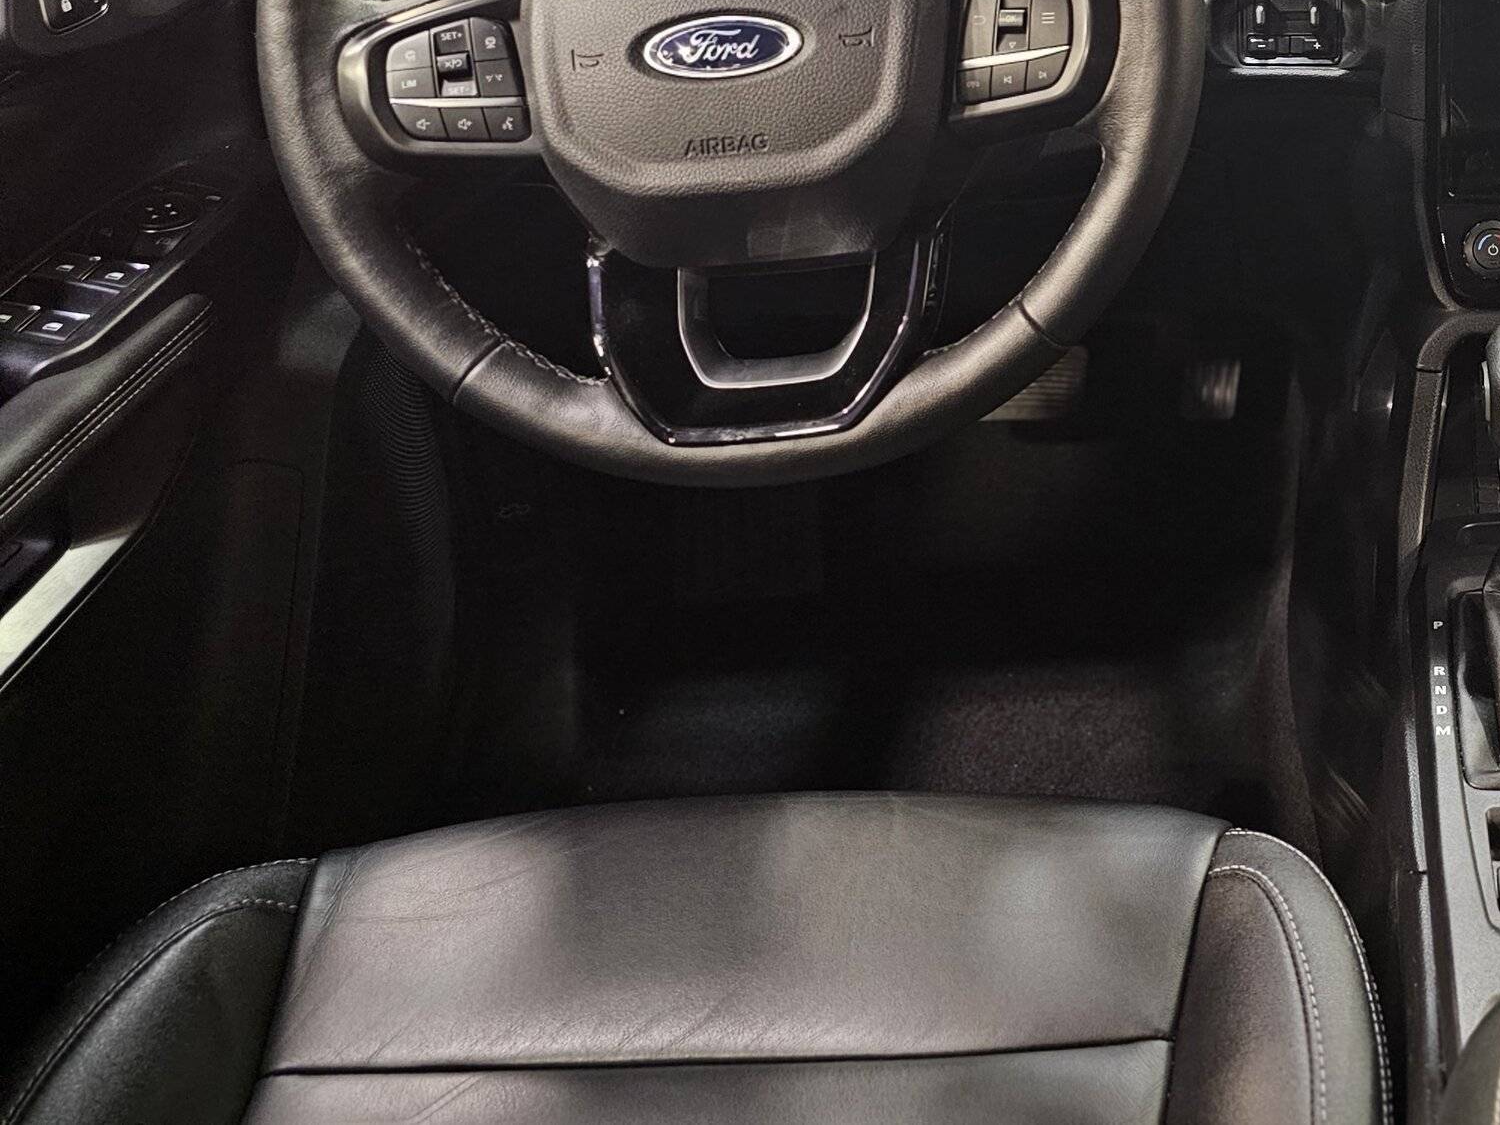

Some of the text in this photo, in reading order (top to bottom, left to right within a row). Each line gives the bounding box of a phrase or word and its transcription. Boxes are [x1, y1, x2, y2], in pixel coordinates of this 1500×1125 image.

[678, 28, 760, 63] Ford
[401, 79, 417, 88] LIM
[684, 132, 769, 157] AIRBAG
[1433, 621, 1444, 630] P
[1433, 666, 1446, 676] R
[1434, 685, 1447, 695] N
[1436, 705, 1448, 715] D
[1435, 725, 1451, 736] M
